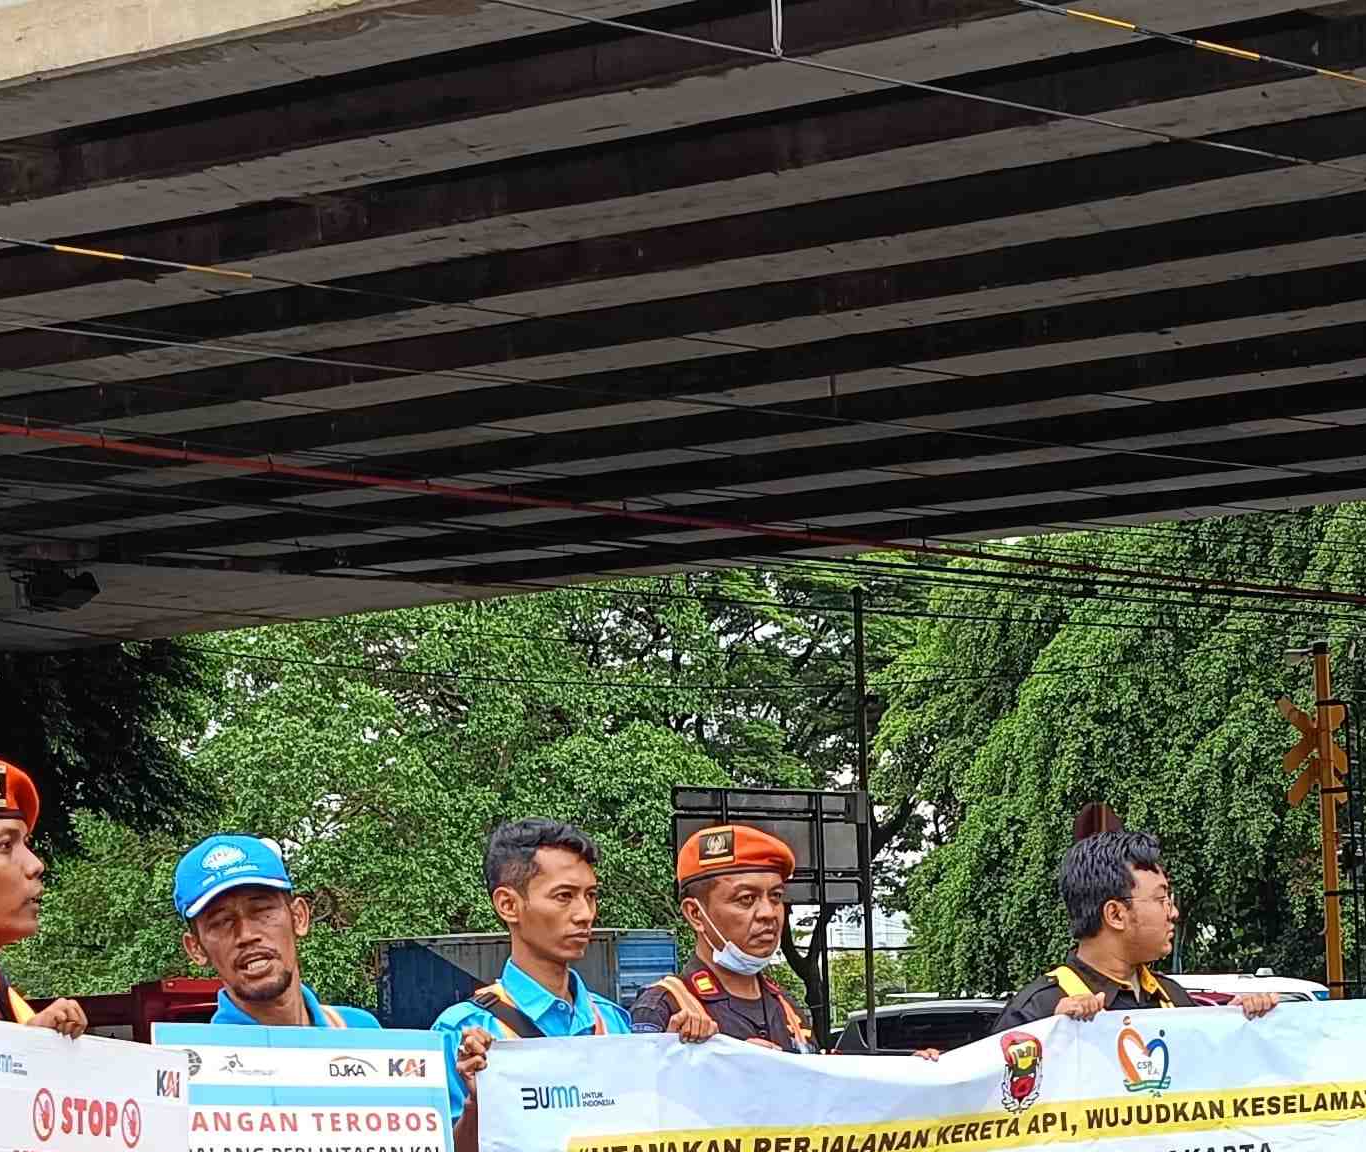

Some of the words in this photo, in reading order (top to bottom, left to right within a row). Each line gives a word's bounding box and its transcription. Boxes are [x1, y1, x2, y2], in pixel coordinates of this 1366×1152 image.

[329, 1063, 367, 1078] DJKA
[388, 1058, 426, 1077] KAI
[156, 1069, 181, 1098] KAI
[582, 1098, 616, 1107] INDONESIA
[61, 1096, 119, 1137] STOP
[191, 1111, 299, 1132] ANGAN
[311, 1112, 438, 1133] TEROBOS
[937, 1116, 1021, 1147] KERETA
[1026, 1110, 1078, 1136] API,
[1086, 1099, 1225, 1130] WUJUDKAN
